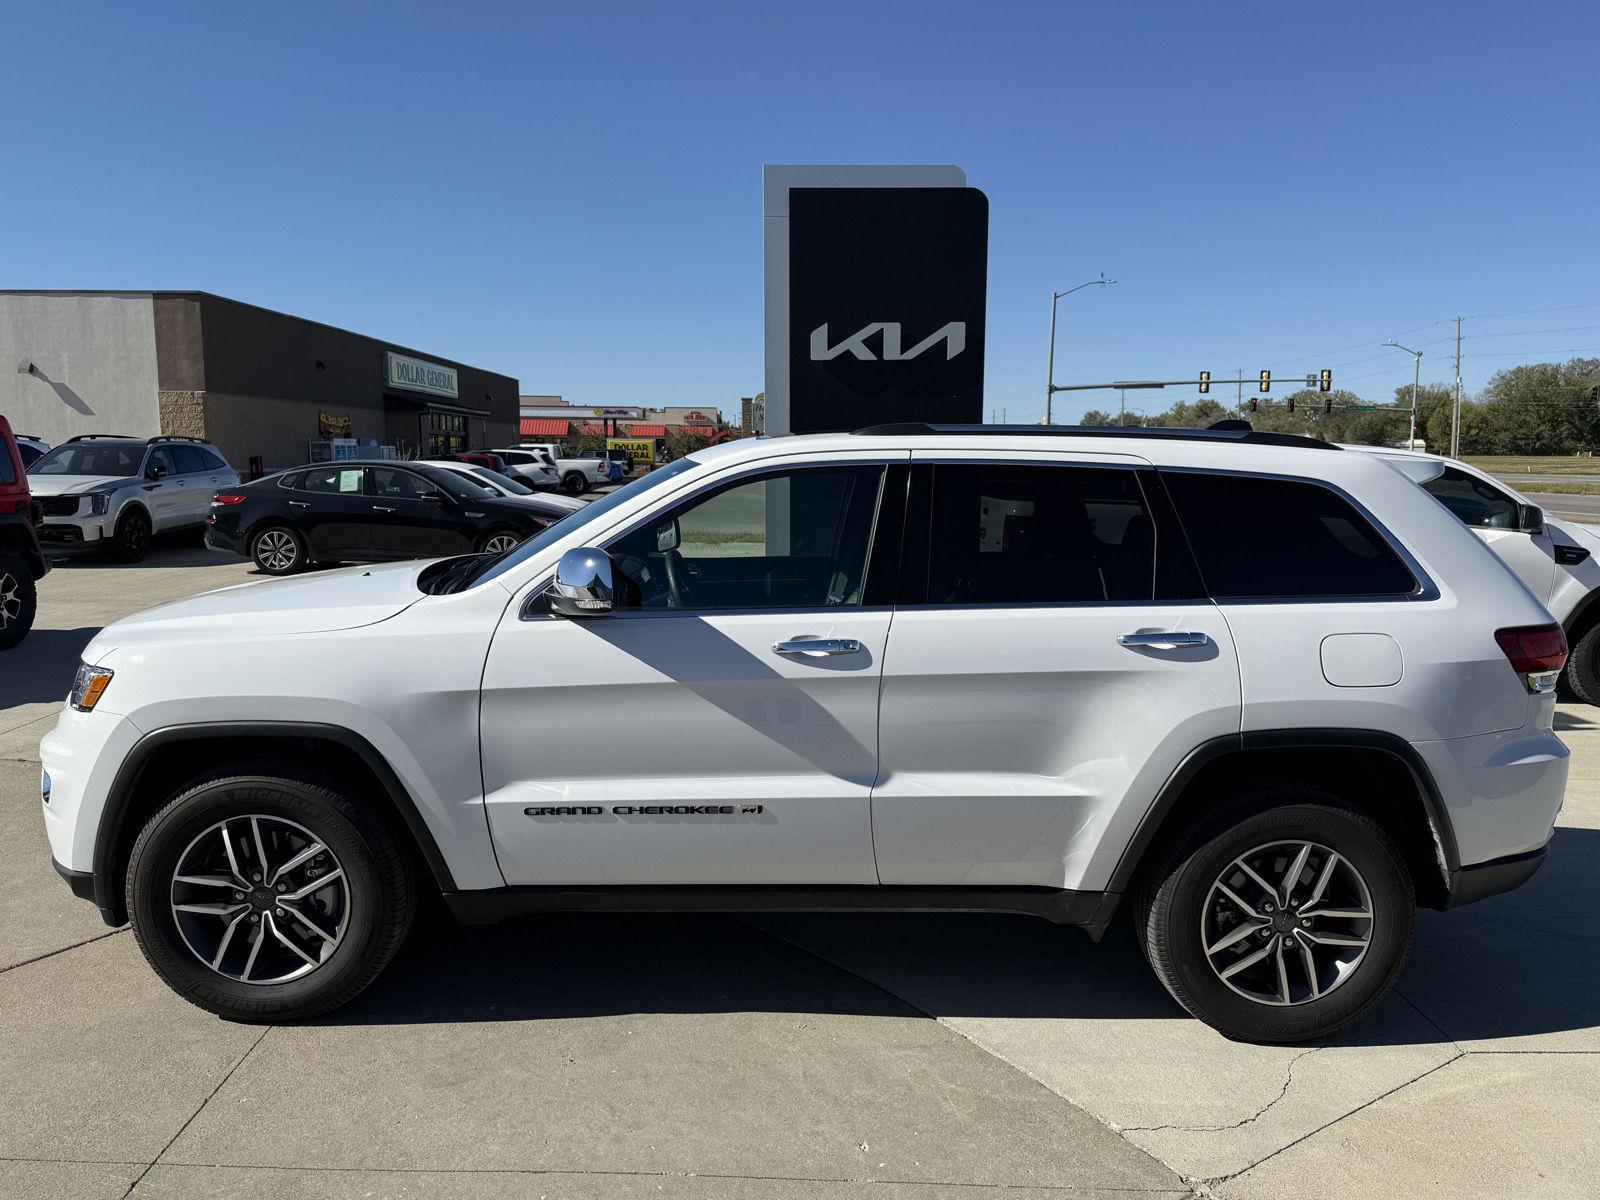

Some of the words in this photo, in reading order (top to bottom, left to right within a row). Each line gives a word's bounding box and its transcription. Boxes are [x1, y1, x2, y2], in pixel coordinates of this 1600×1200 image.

[396, 361, 425, 385] DOLLAR
[427, 368, 456, 391] GENERAL
[614, 443, 649, 451] DOLLAR
[524, 806, 603, 816] GRAND
[612, 804, 734, 815] CHEROKEE
